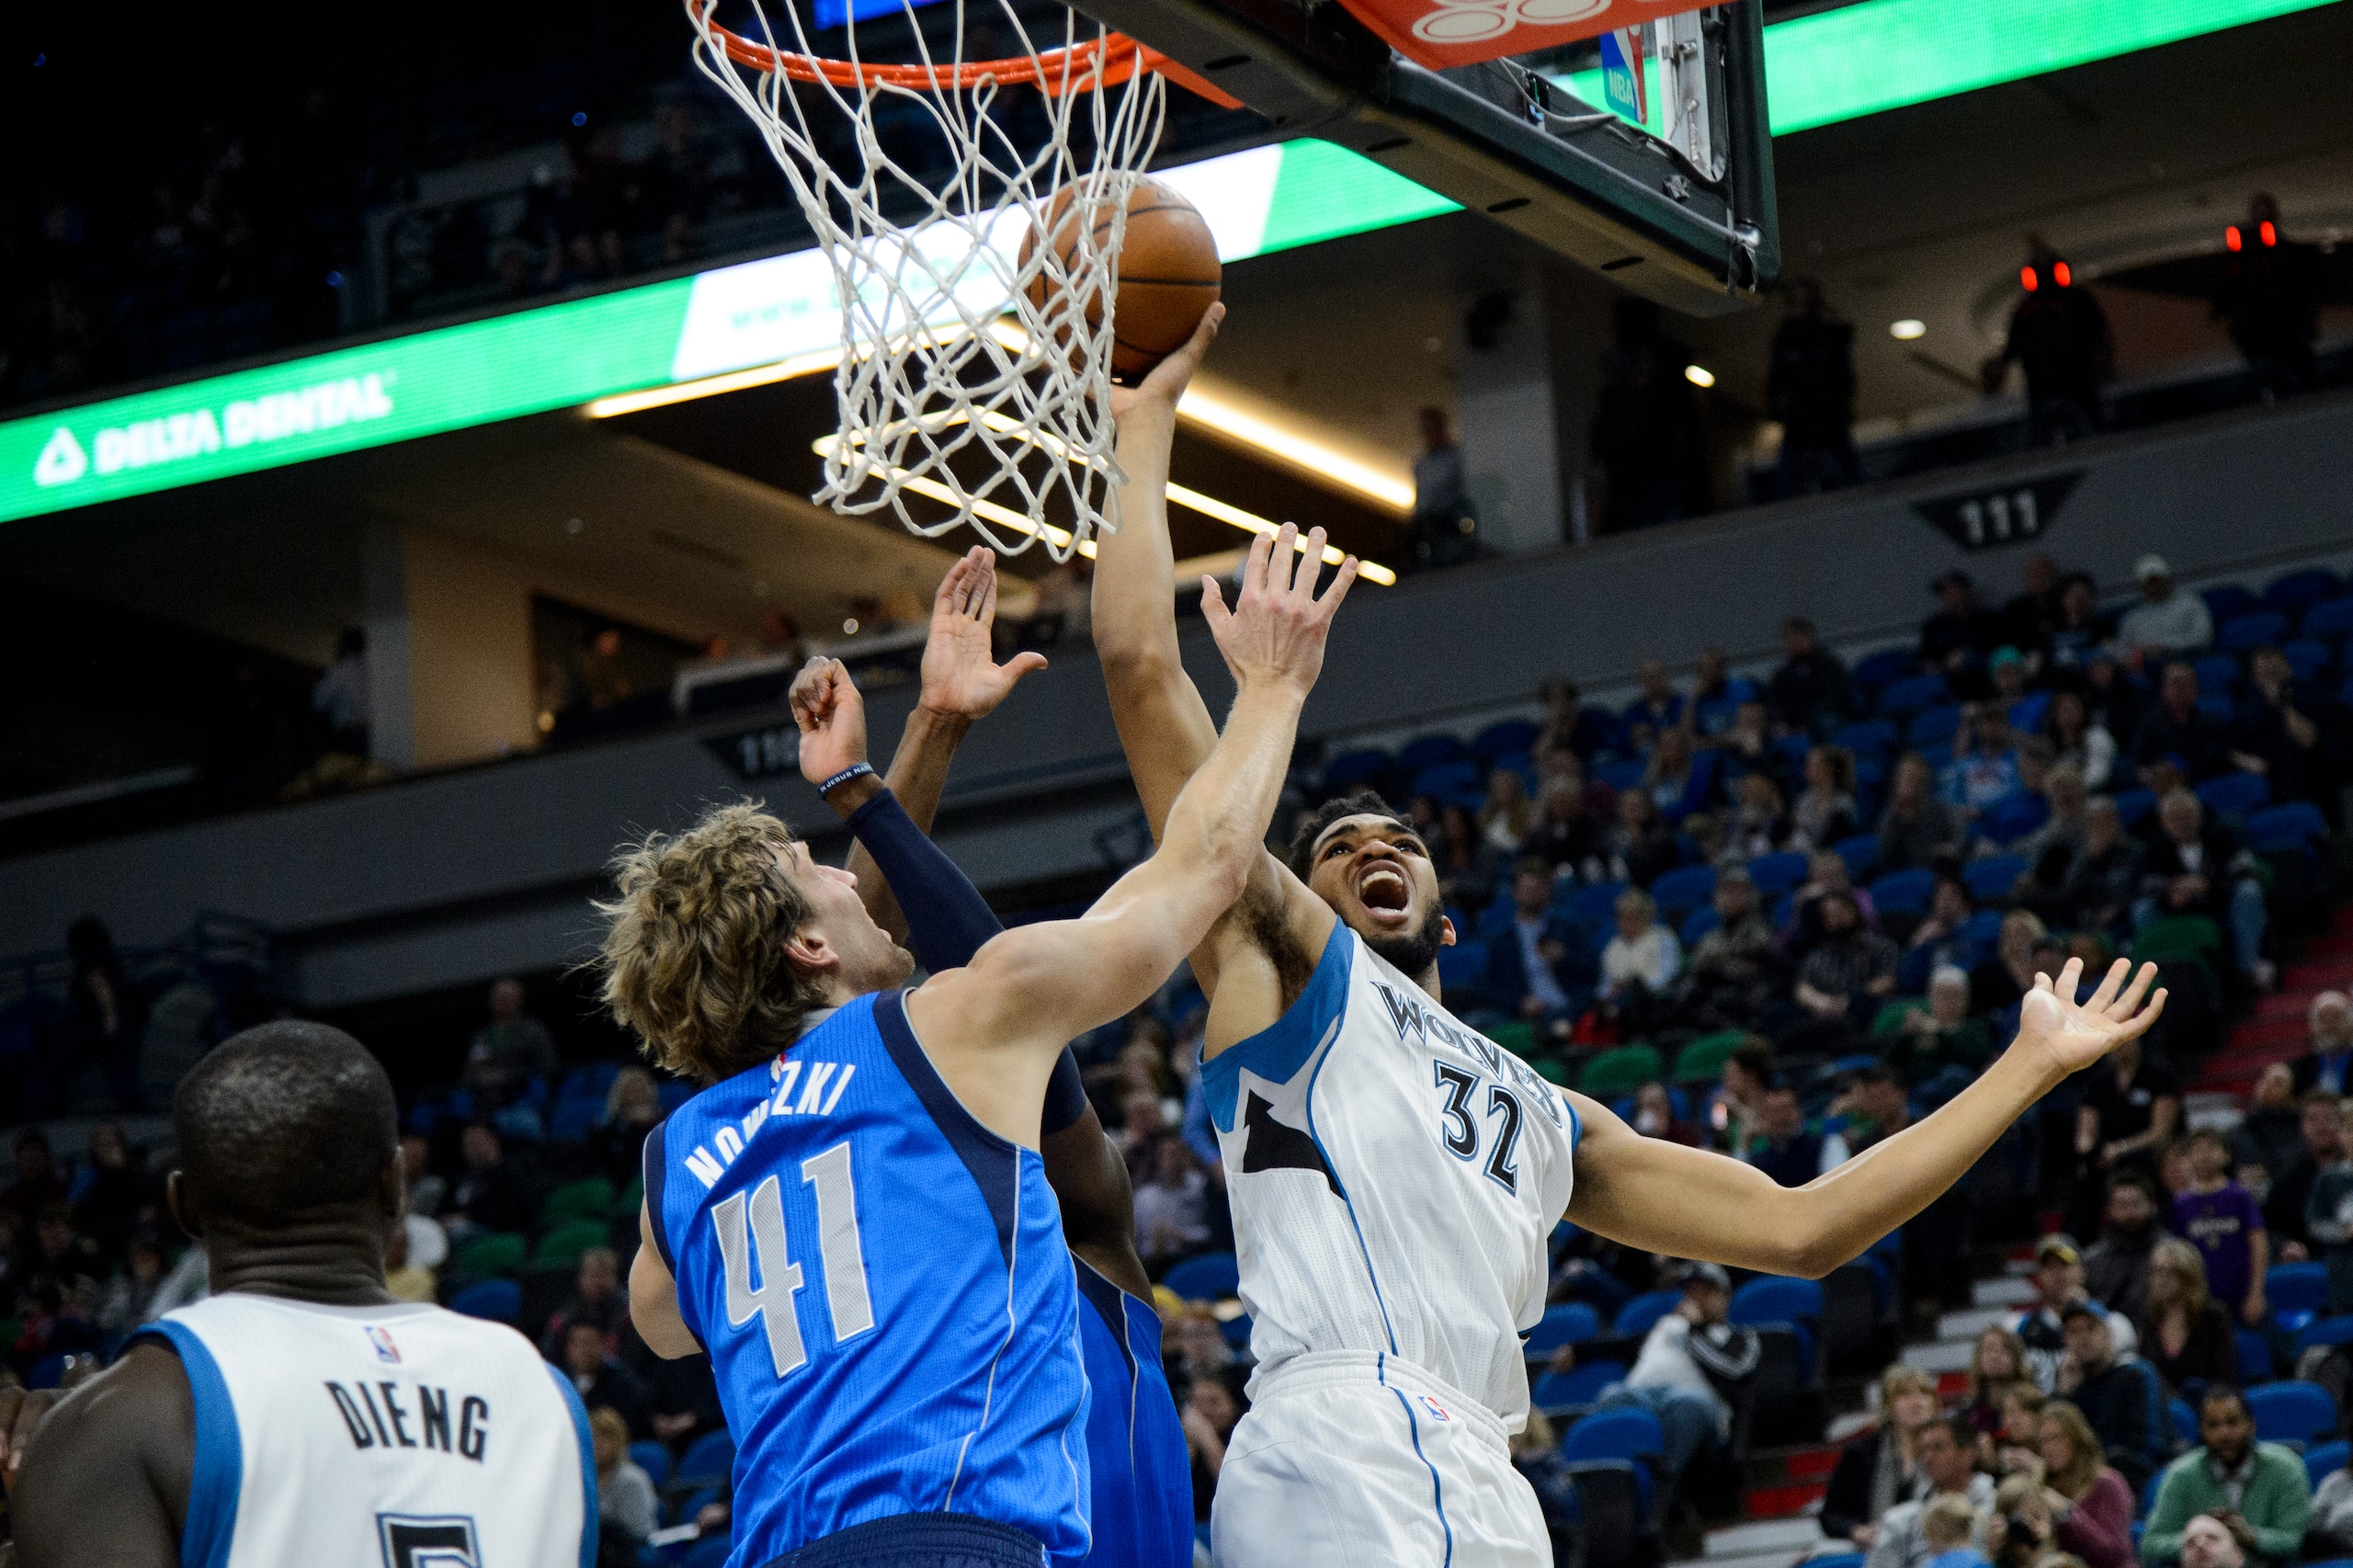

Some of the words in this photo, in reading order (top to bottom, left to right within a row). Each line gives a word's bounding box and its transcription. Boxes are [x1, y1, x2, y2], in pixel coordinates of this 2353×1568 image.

[1608, 68, 1635, 108] NBA
[94, 408, 222, 475] DELTA
[223, 373, 392, 448] DENTAL
[1958, 489, 2038, 544] 111
[1370, 981, 1563, 1129] WOLVES
[1433, 1059, 1523, 1198] 32
[711, 1141, 875, 1379] 41
[324, 1380, 490, 1464] DIENG
